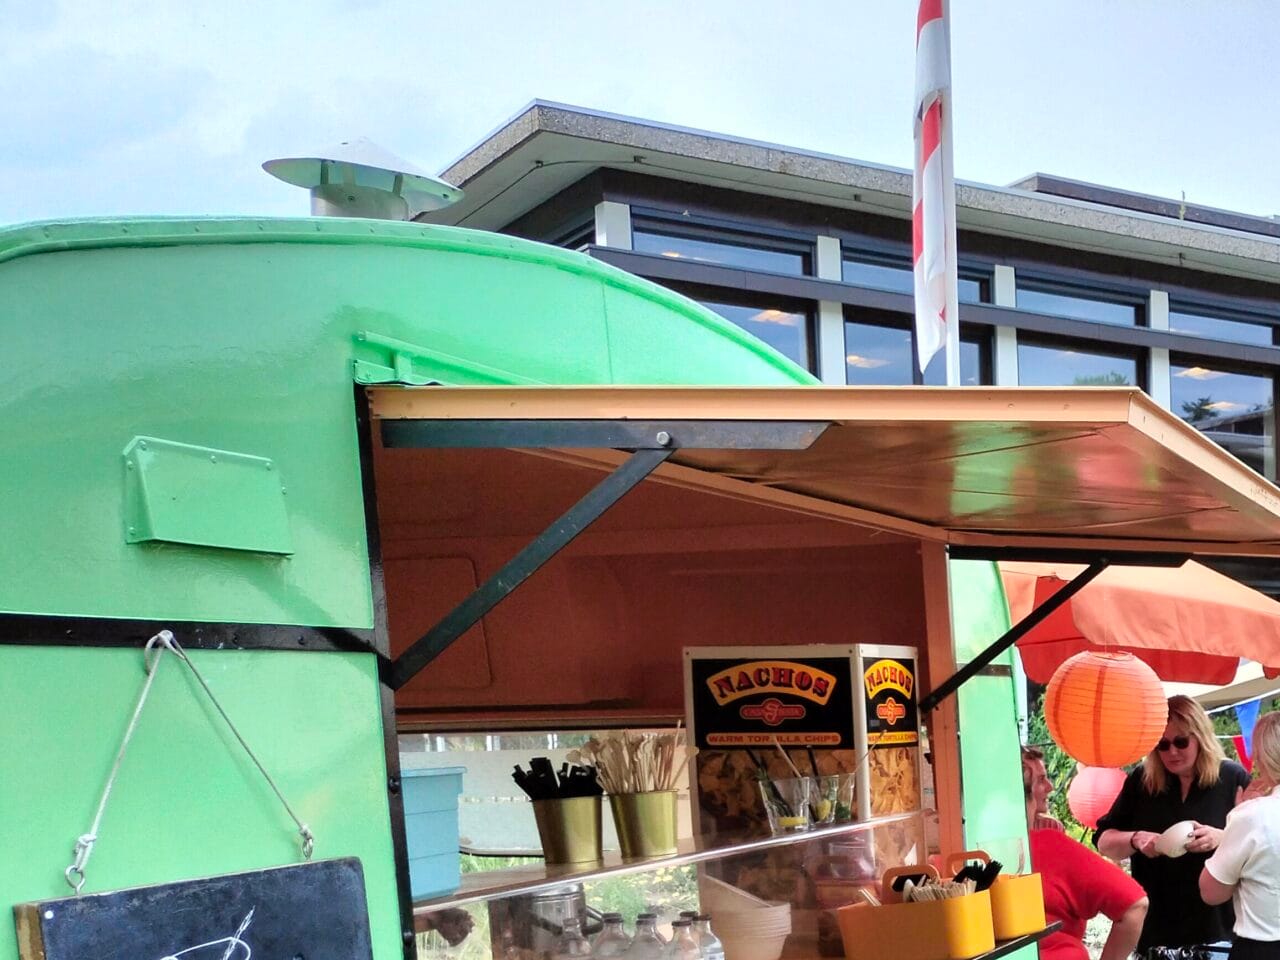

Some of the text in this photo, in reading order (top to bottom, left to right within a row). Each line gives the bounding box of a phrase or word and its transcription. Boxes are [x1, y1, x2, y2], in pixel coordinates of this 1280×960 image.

[713, 667, 830, 698] NACHOS
[709, 735, 840, 743] WARM TORILLA CHIPS
